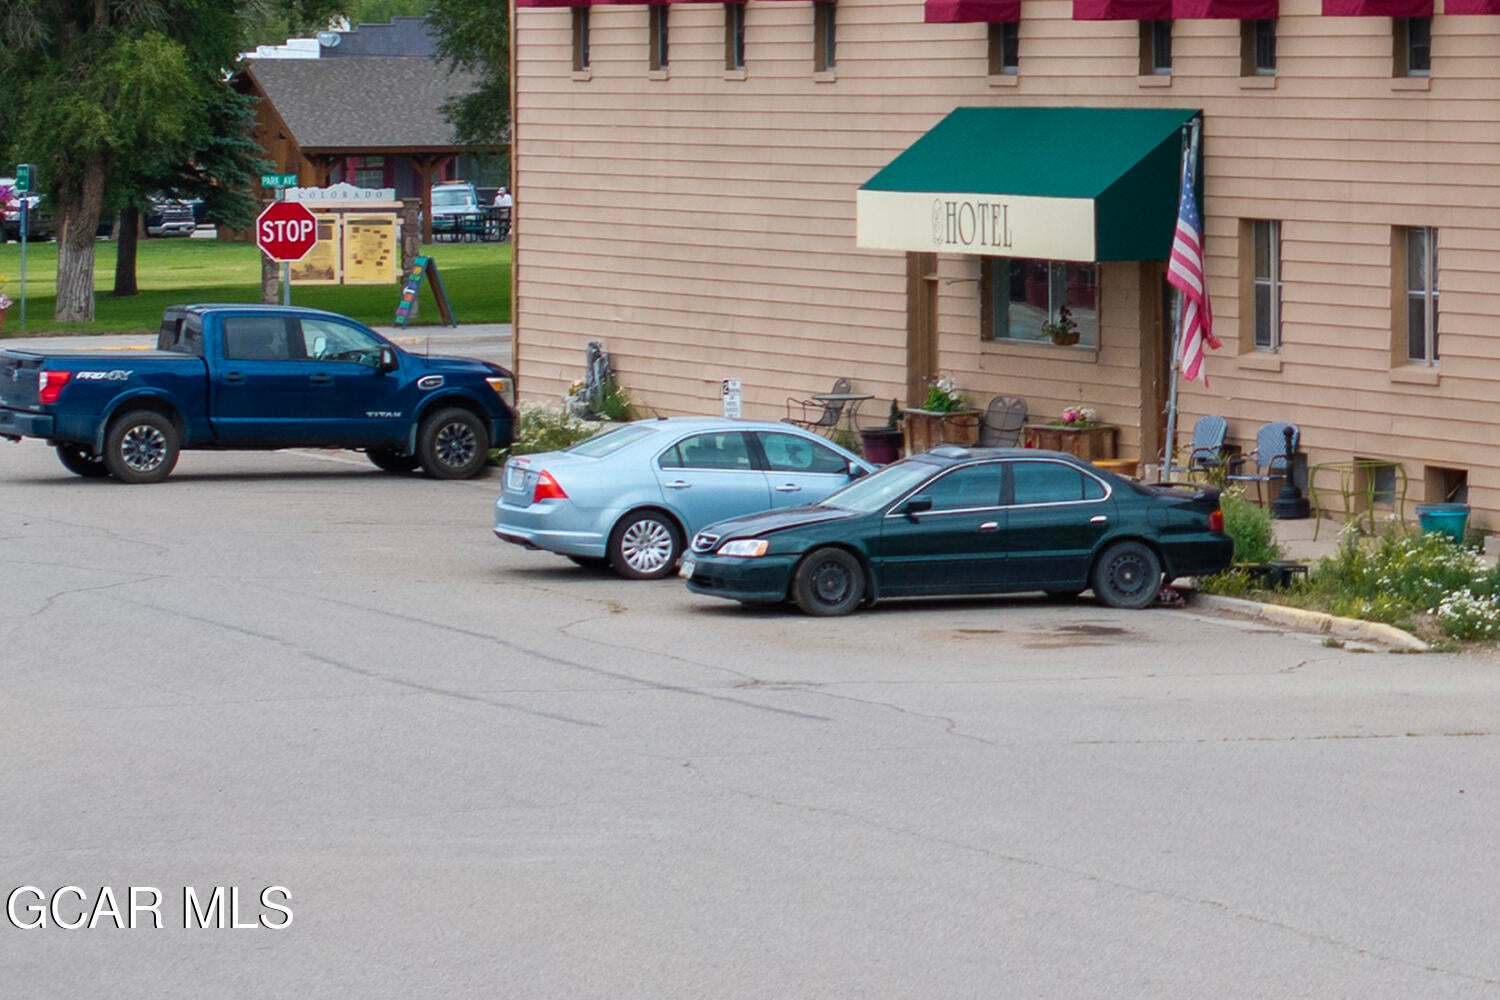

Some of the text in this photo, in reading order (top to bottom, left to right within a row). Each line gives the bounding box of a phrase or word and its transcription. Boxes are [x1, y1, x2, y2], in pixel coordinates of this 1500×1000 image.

[262, 174, 297, 186] PARK AVE
[298, 190, 383, 200] COLORADO
[262, 219, 314, 243] STOP
[945, 201, 1013, 249] HOTEL
